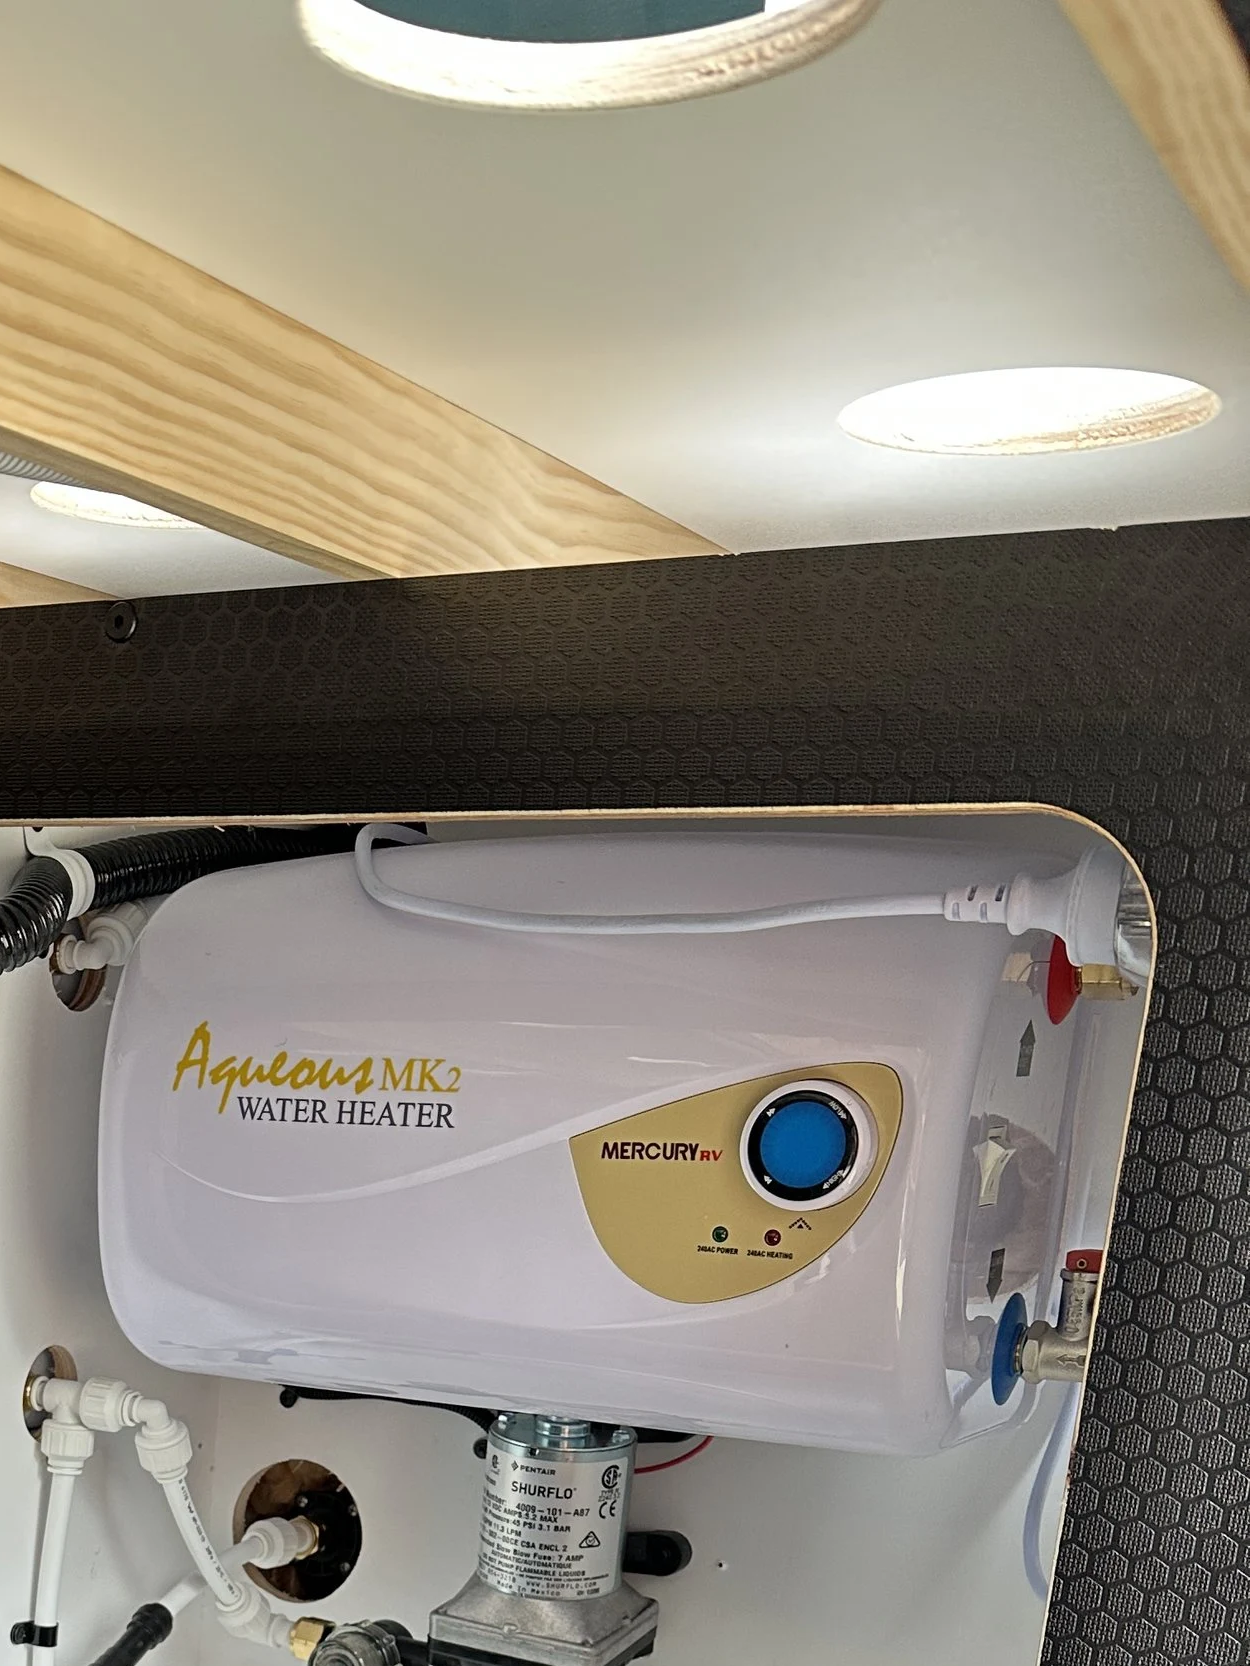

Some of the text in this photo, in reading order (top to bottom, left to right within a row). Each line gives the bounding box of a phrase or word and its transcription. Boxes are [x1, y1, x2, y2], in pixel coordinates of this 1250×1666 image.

[172, 1020, 462, 1114] Aqueous MK2
[237, 1096, 455, 1129] WATER HEATER
[716, 1247, 739, 1255] POWER
[766, 1251, 793, 1260] HEATING
[520, 1466, 556, 1476] PENTAIR
[540, 1515, 558, 1523] MAX
[521, 1540, 536, 1549] CSA
[539, 1543, 560, 1552] ENCL
